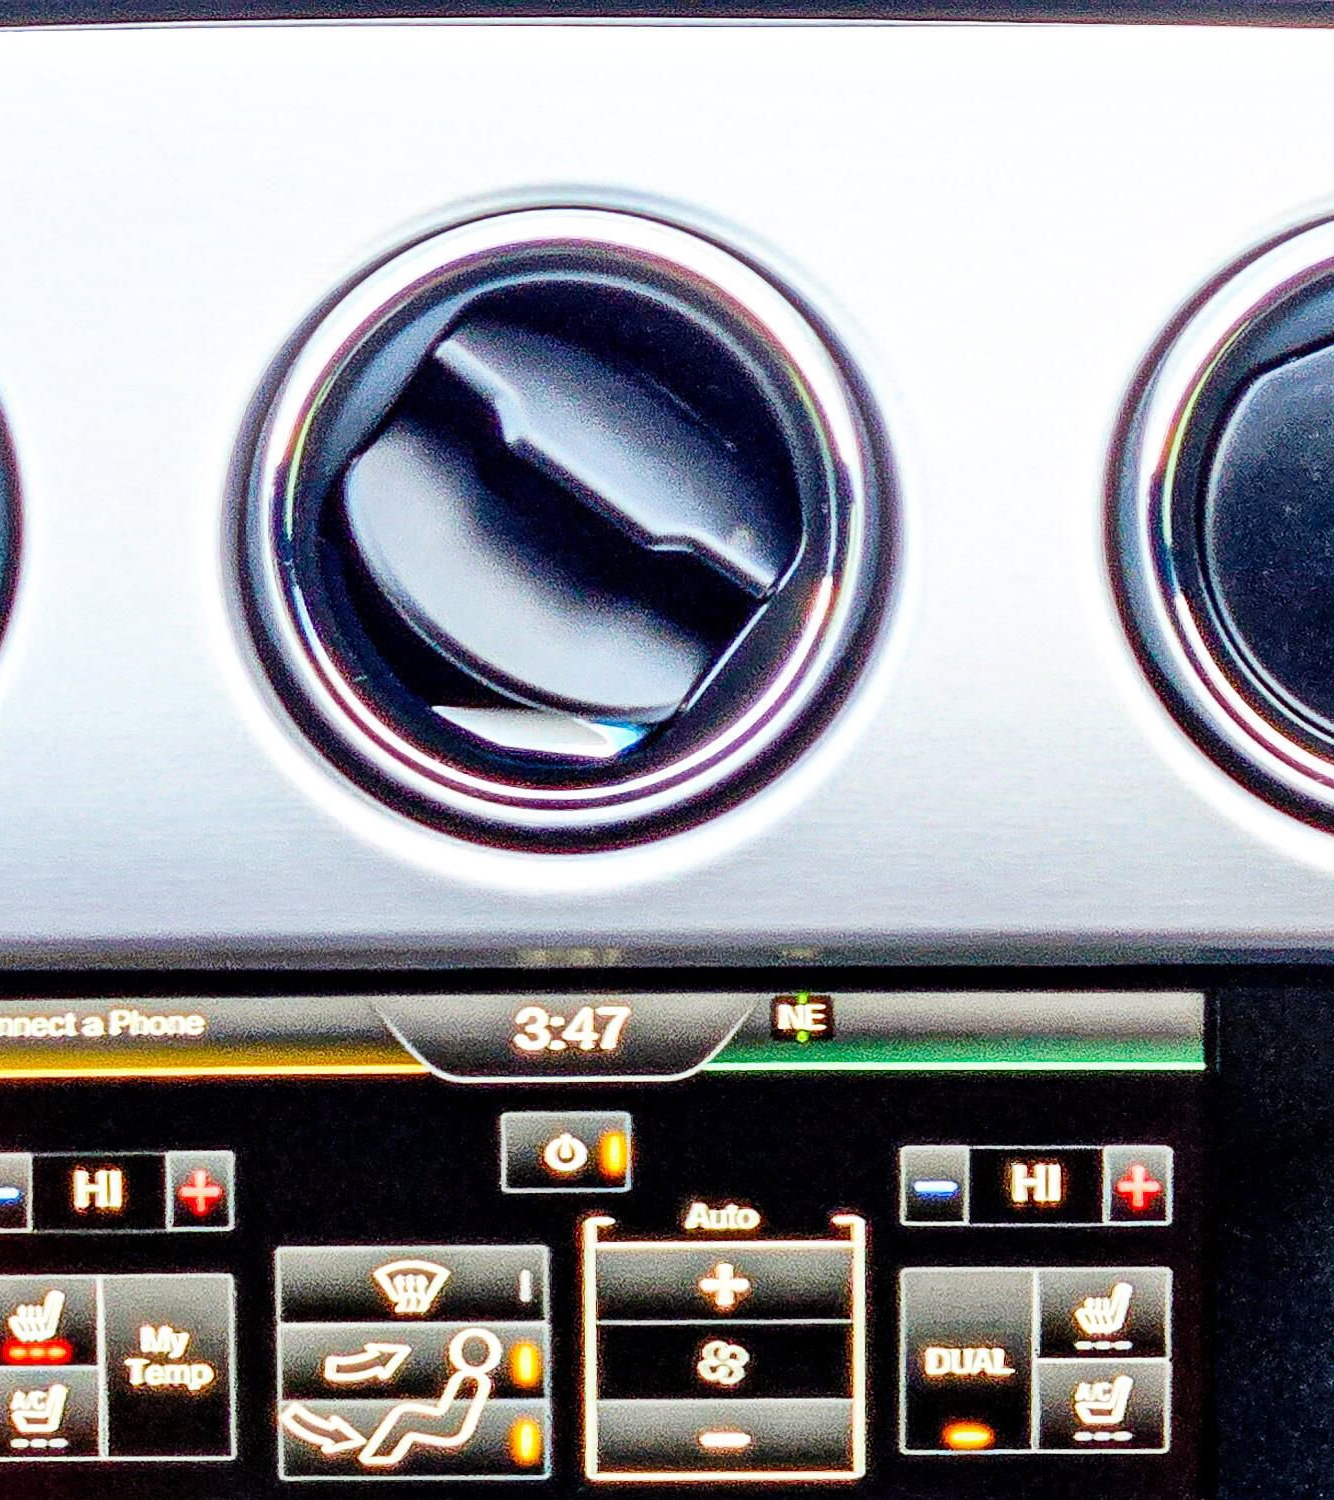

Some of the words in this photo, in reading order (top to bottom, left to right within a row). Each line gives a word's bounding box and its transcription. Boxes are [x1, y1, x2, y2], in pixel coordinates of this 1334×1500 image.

[81, 1015, 107, 1037] a
[109, 1009, 206, 1036] Phone
[513, 1006, 631, 1051] 3:47
[776, 1003, 827, 1031] NE
[74, 1169, 123, 1211] HI
[1011, 1163, 1062, 1204] HI
[684, 1203, 761, 1231] Auto
[139, 1324, 190, 1359] My
[124, 1357, 215, 1391] Temp
[925, 1346, 1016, 1376] DUAL
